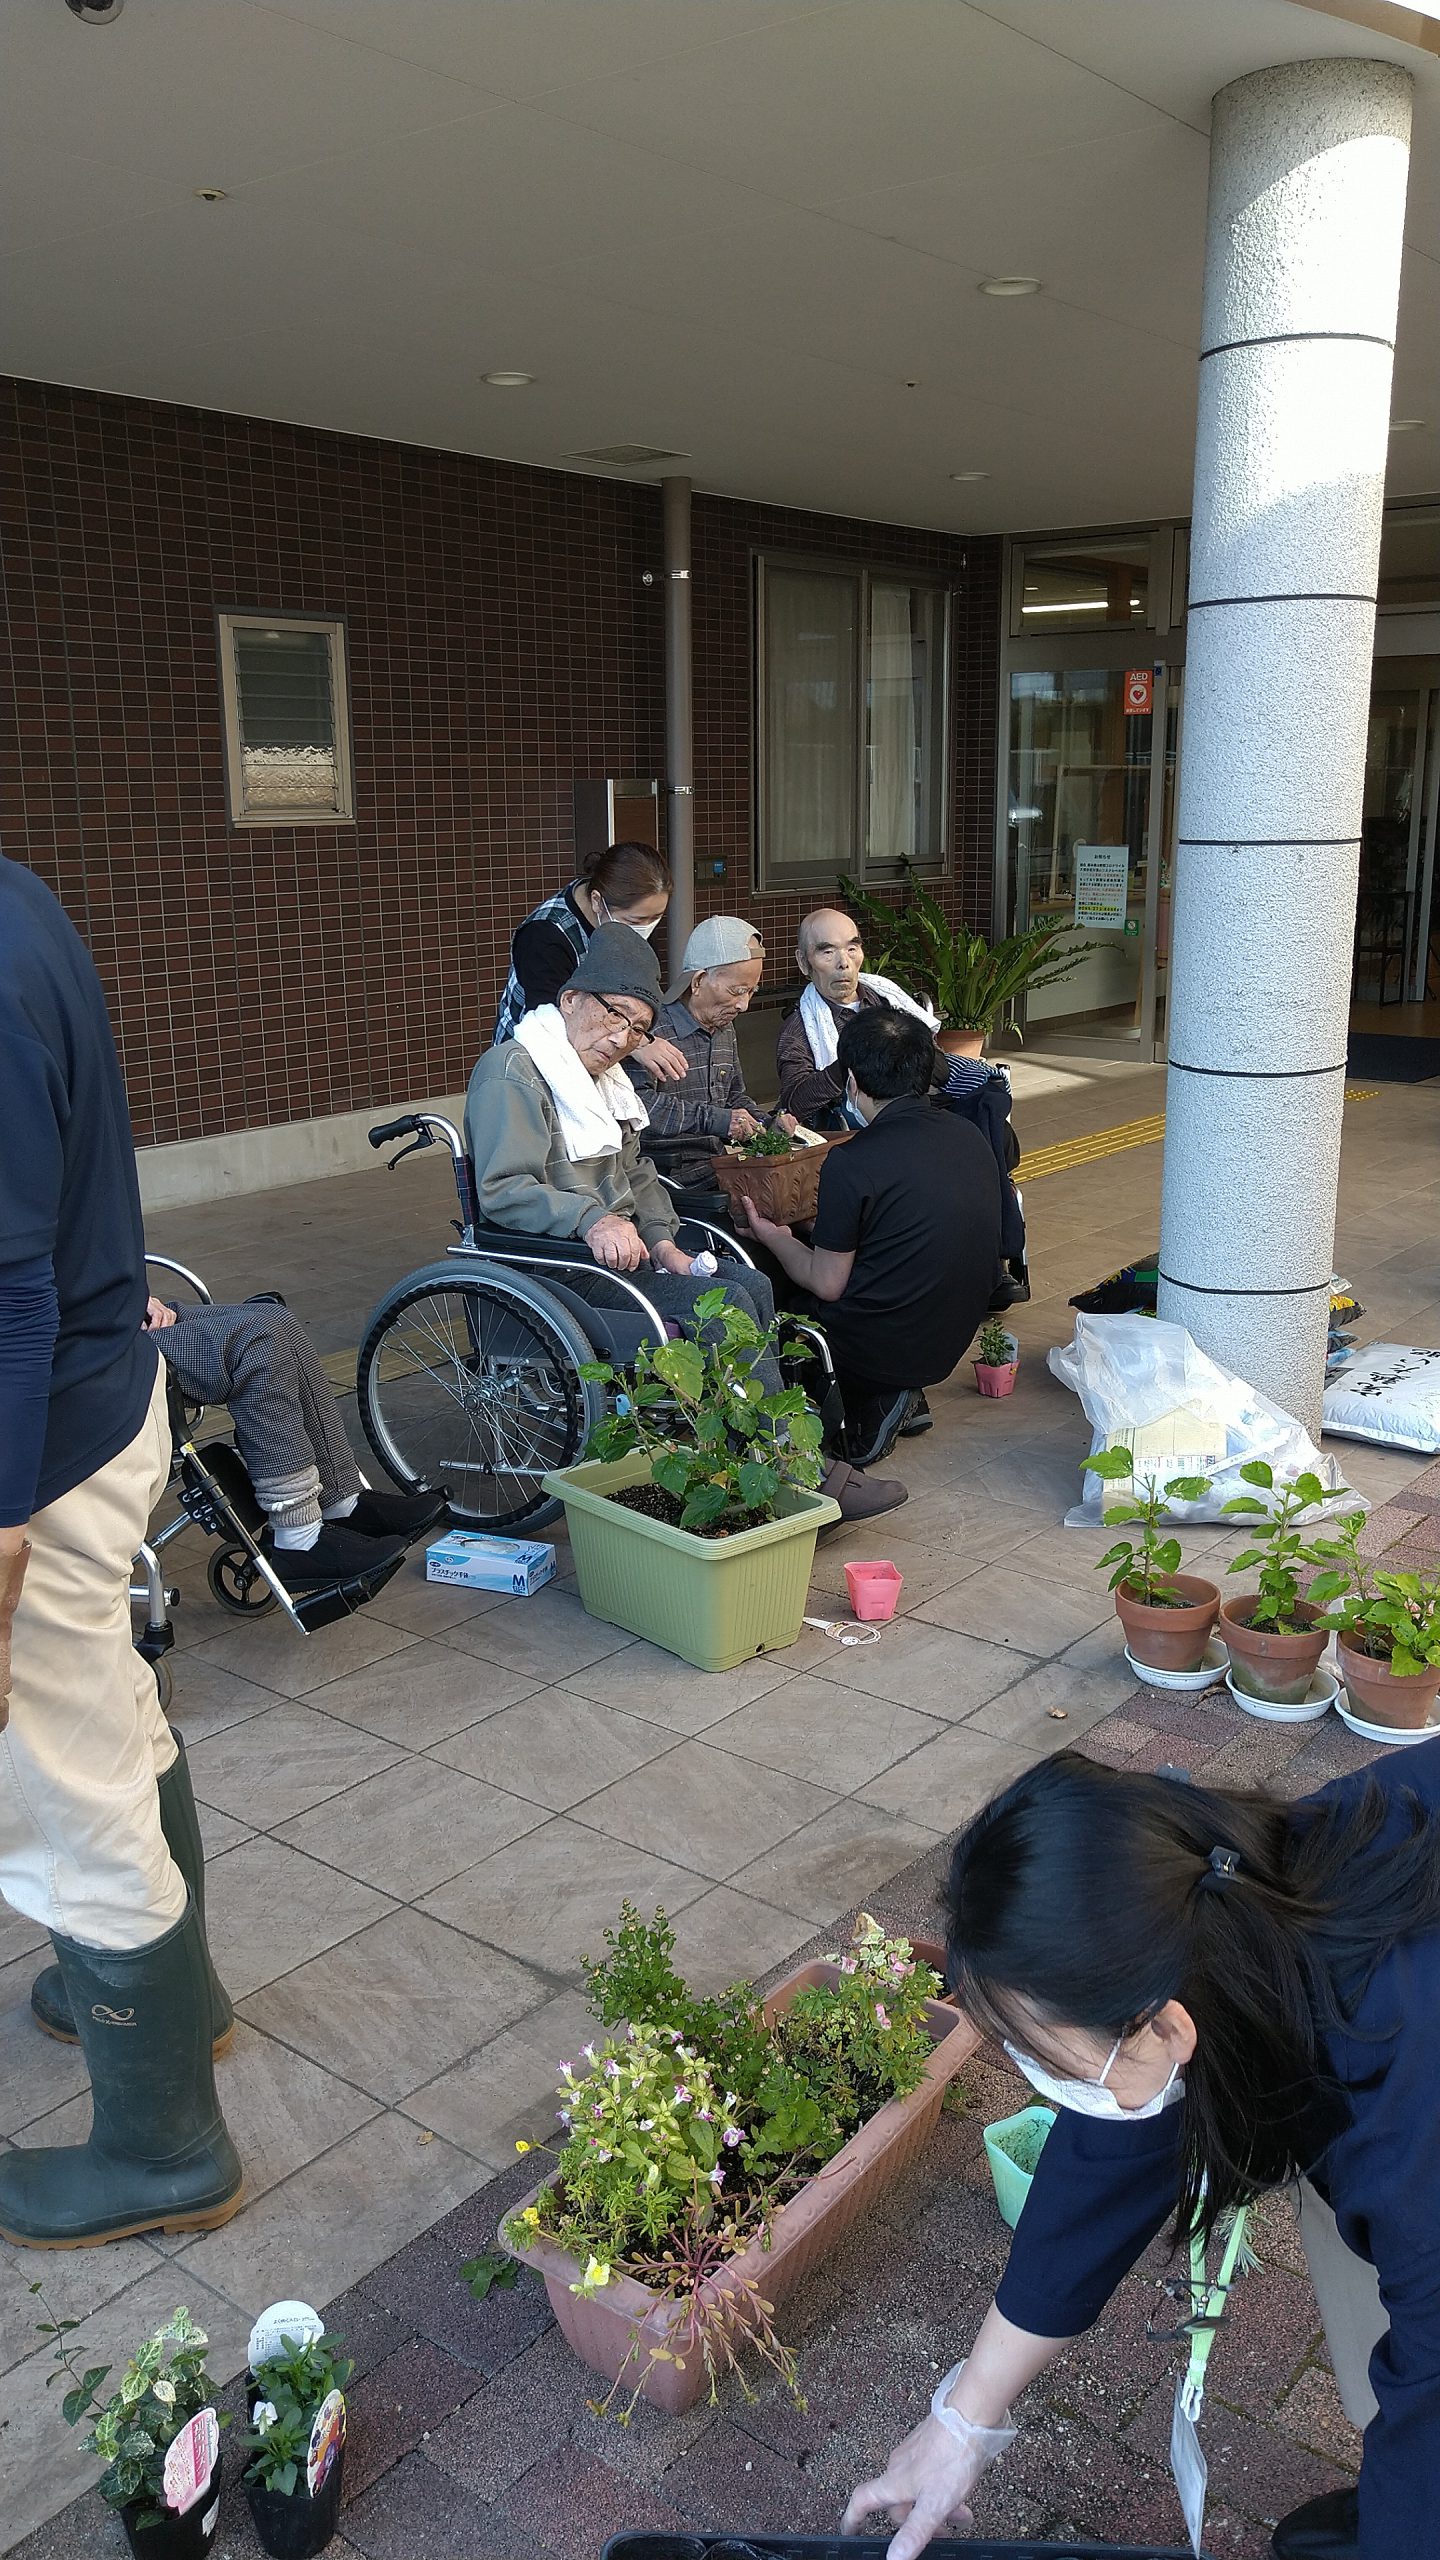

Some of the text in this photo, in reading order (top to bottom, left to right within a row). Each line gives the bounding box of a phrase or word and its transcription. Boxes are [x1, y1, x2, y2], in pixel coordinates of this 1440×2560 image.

[1130, 672, 1148, 681] AED
[517, 1554, 532, 1563] M
[431, 1567, 469, 1579] プラスチック手袋
[512, 1574, 525, 1587] M
